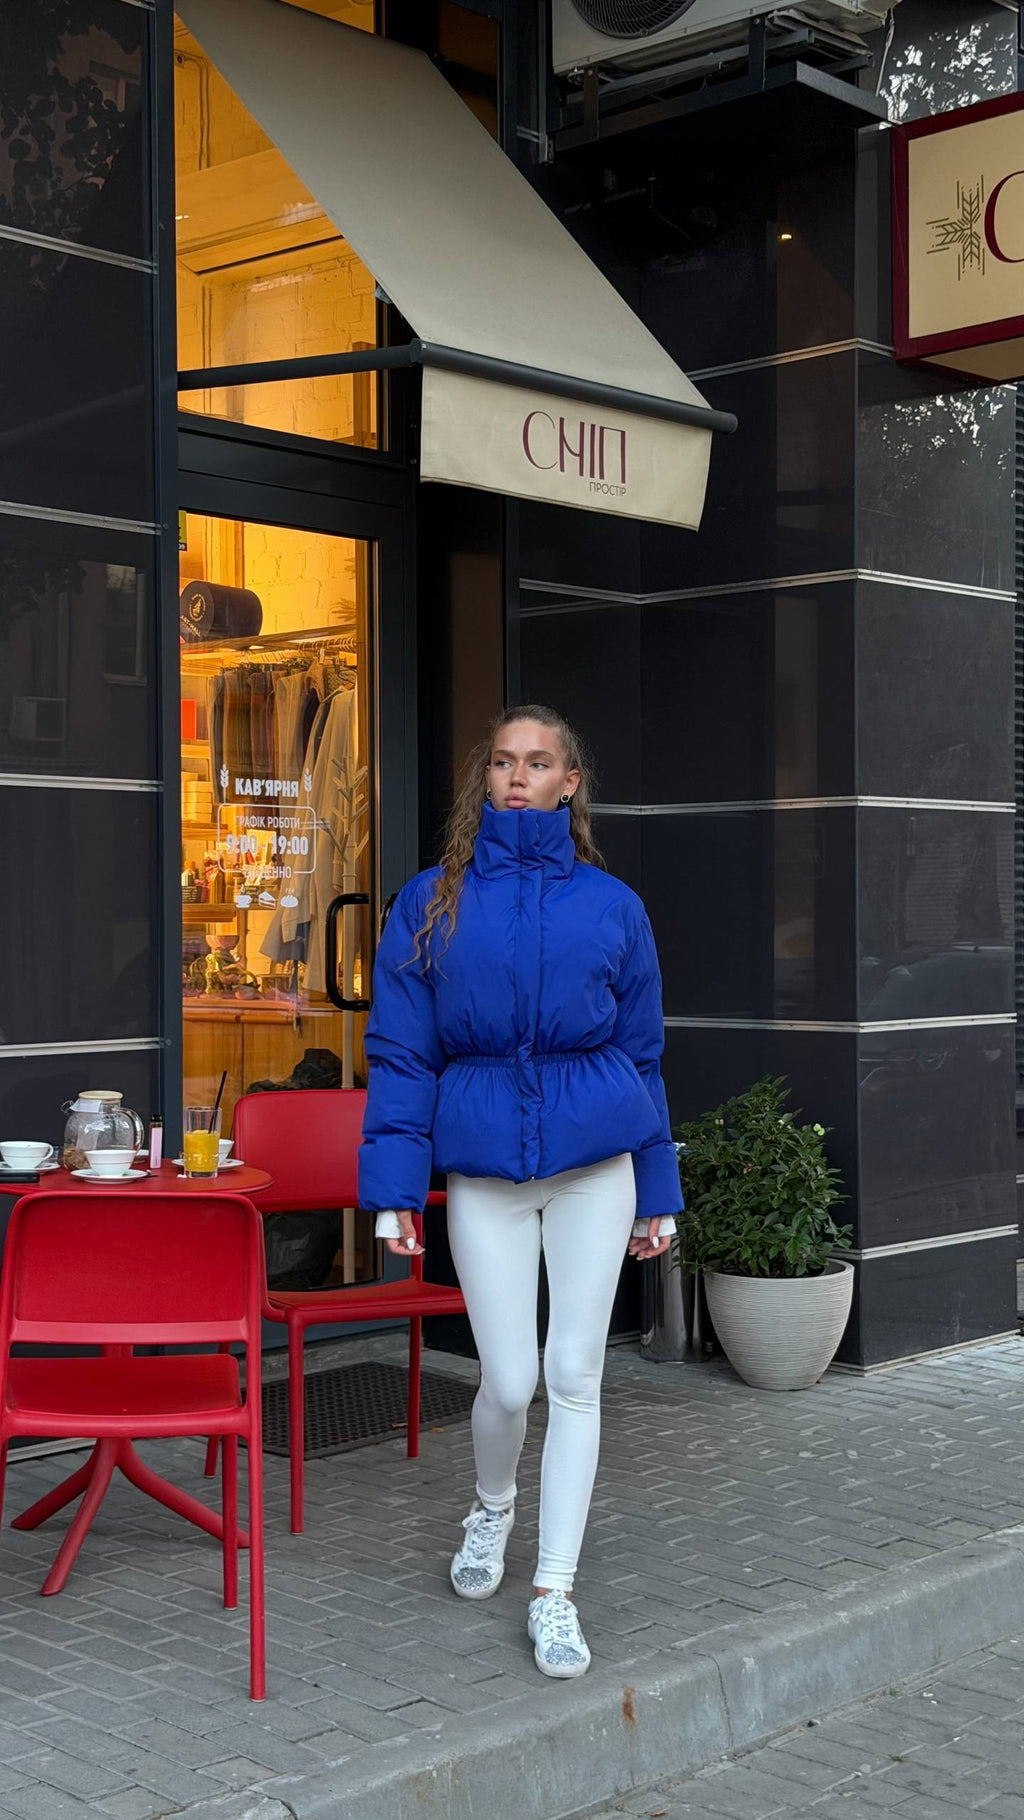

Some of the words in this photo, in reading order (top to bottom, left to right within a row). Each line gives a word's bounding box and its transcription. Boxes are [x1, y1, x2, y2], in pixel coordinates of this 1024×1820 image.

[522, 410, 626, 484] СНІП
[589, 481, 627, 497] ПРОСТІР
[235, 778, 299, 798] КАВ'ЯРНЯ
[236, 815, 266, 829] ГРАФІК
[267, 816, 300, 829] РОБОТИ
[226, 834, 258, 854] 9:00
[271, 835, 309, 855] 19:00
